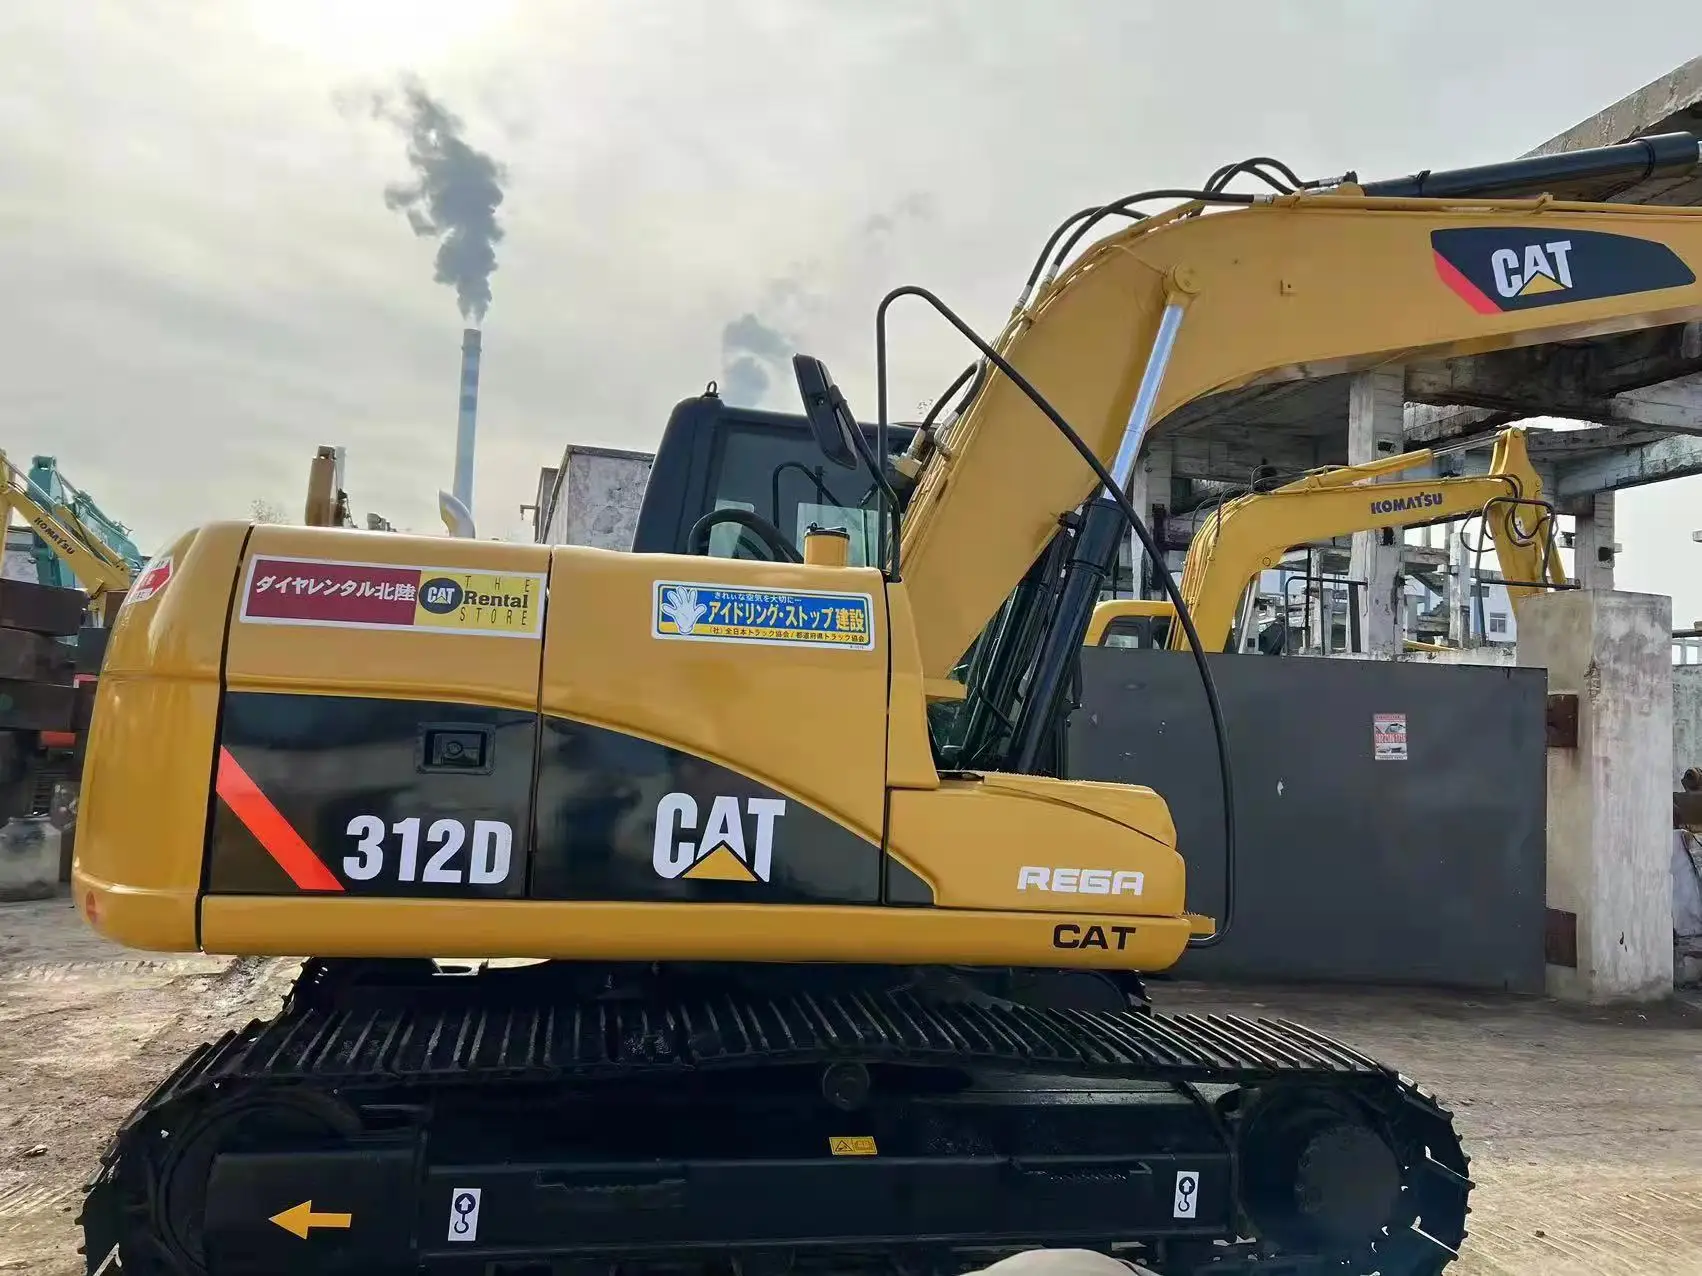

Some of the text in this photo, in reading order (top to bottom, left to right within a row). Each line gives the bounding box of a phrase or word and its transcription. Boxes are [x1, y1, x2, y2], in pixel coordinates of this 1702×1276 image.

[1491, 240, 1573, 298] CAT
[1371, 492, 1443, 514] KOMATSU
[34, 517, 75, 555] KOMATSU
[256, 575, 417, 602] ダイヤレンタル北陸
[427, 586, 453, 605] CAT
[464, 575, 533, 592] THE
[463, 590, 529, 609] Rental
[459, 608, 529, 626] STORE
[343, 815, 513, 884] 312D
[652, 792, 786, 883] CAT
[1017, 866, 1144, 896] REGA
[1053, 924, 1137, 951] CAT
